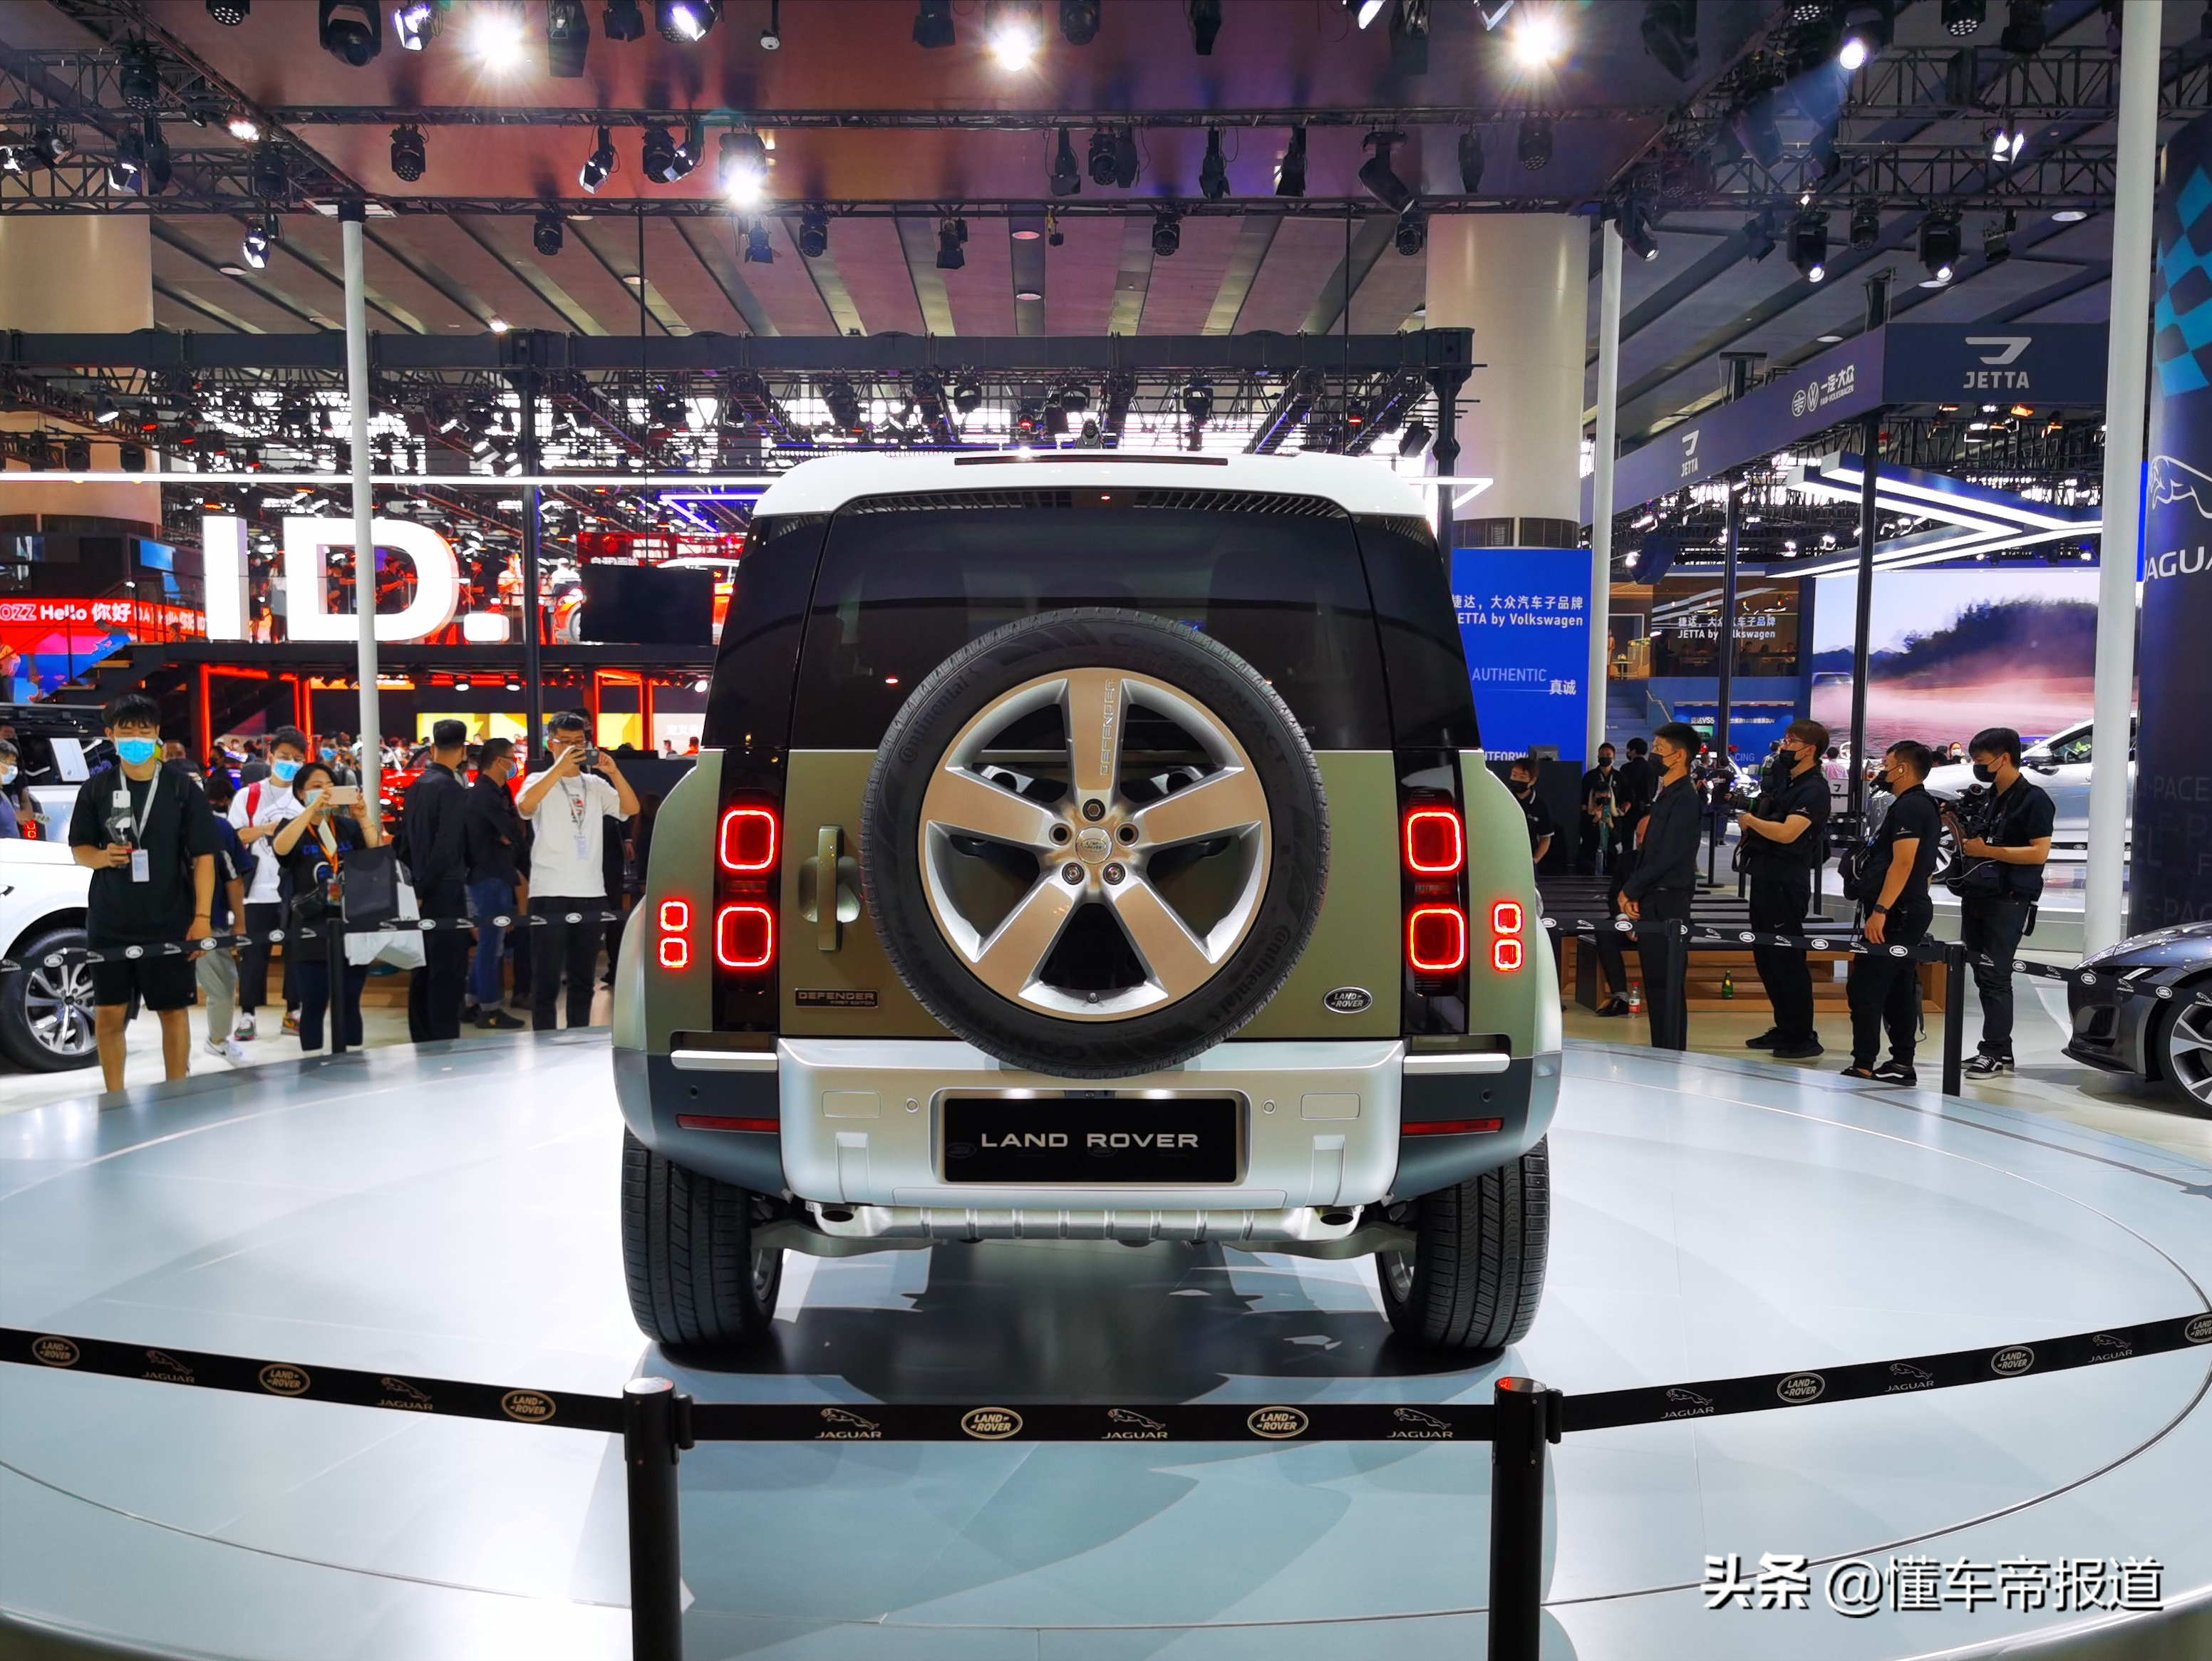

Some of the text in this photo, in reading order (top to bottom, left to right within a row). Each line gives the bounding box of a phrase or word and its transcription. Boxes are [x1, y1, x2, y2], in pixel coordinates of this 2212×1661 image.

[1963, 371, 2030, 388] JETTA
[1680, 457, 1698, 478] JETTA
[40, 604, 87, 621] Hello
[91, 602, 131, 622] 你好
[1457, 613, 1583, 628] ETTA by Volkswagen
[1678, 629, 1776, 640] JETTA by lkswagen
[1472, 668, 1548, 682] AUTHENTIC
[1549, 680, 1577, 695] 真诚
[898, 675, 971, 766] Continental
[1100, 678, 1115, 776] DEFENDER
[798, 992, 874, 1000] DEFENDER
[981, 1133, 1199, 1148] LAND ROVER
[2088, 1349, 2134, 1362] JAGUAR
[141, 1372, 195, 1383] JAGUAR
[1884, 1380, 1934, 1392] JAGUAR
[376, 1399, 433, 1411] JAGUAR
[1660, 1407, 1715, 1419] JAGUAR
